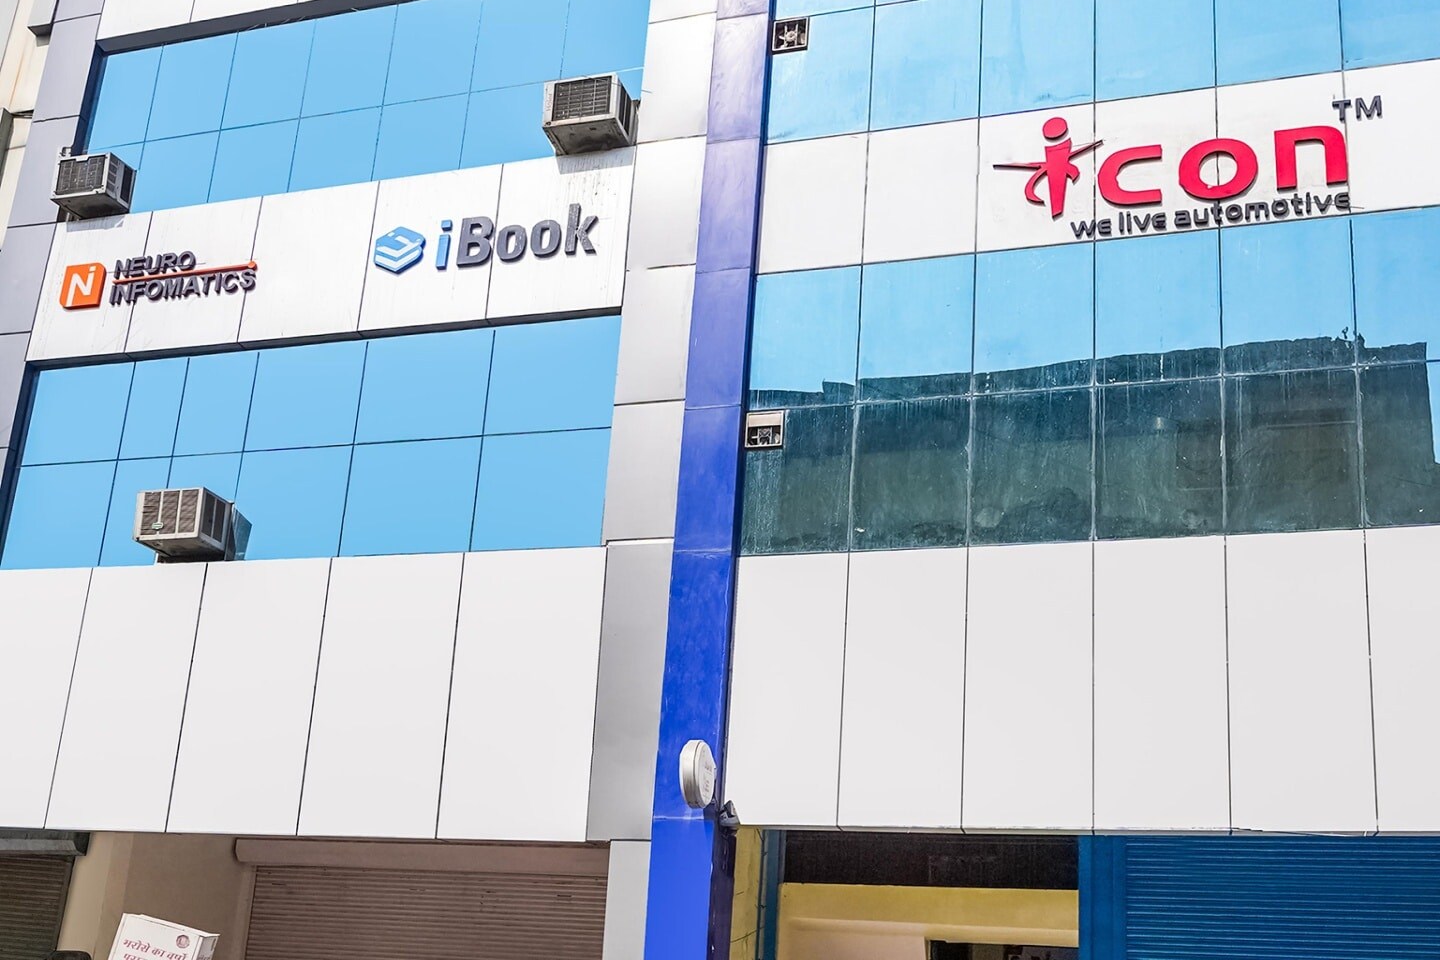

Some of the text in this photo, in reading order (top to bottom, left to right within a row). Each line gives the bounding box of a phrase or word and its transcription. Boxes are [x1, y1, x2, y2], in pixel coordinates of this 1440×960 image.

[1071, 191, 1351, 239] we live automotive
[435, 203, 598, 271] iBook
[113, 251, 197, 280] NEURO
[109, 269, 257, 307] INFOMATICS
